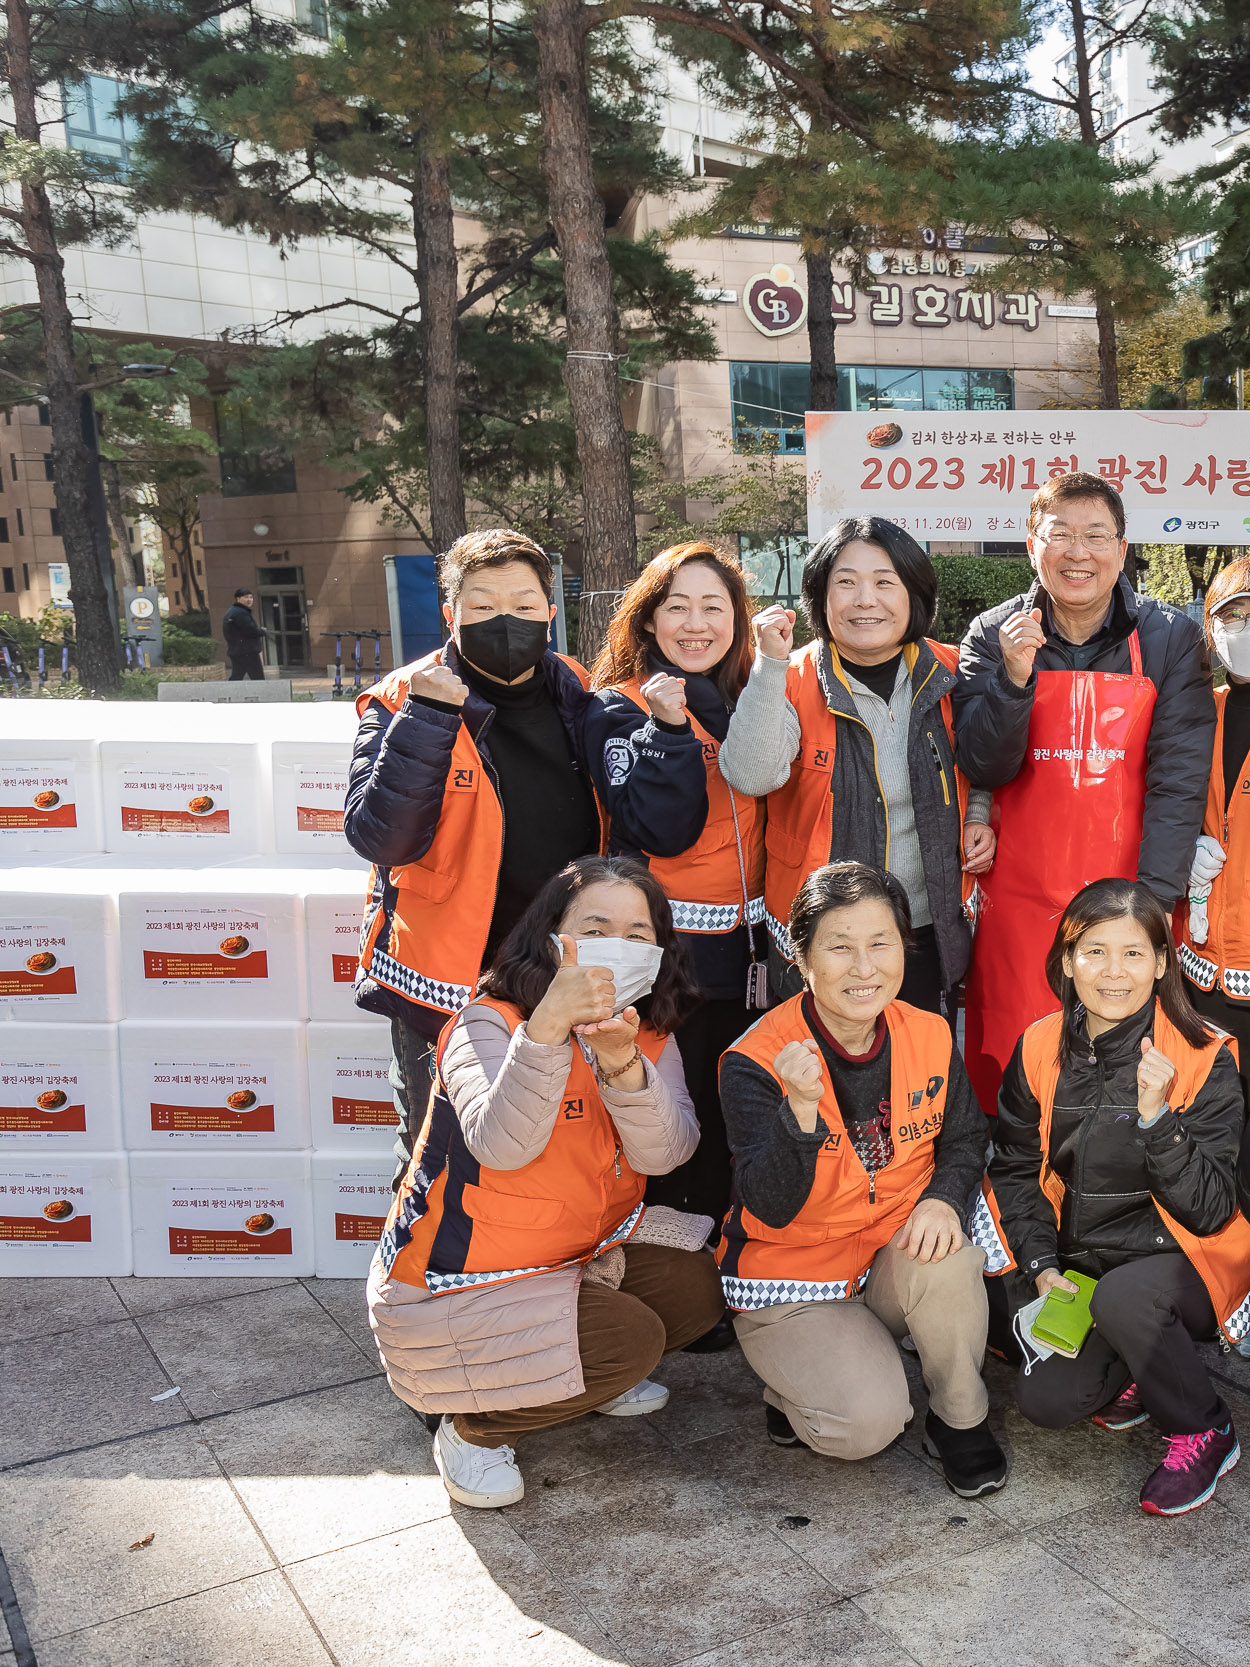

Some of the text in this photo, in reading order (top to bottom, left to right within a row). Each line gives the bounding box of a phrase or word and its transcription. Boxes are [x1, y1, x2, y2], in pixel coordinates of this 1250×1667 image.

[911, 431, 1077, 446] 김치 한상자로 전하는 안부
[860, 456, 966, 492] 2023
[1097, 454, 1168, 495] 광진
[935, 516, 973, 531] 20(월)
[1185, 520, 1221, 530] 광진구
[137, 601, 148, 615] P
[1033, 748, 1051, 761] 광진
[1053, 748, 1084, 761] 사랑의
[2, 778, 68, 788] 광진 사랑의 김장축제
[453, 769, 474, 788] 진
[159, 783, 173, 791] 광진
[174, 783, 194, 792] 사랑의
[197, 783, 223, 792] 김장축제
[146, 922, 163, 930] 2023
[186, 922, 201, 931] 광진
[203, 922, 226, 931] 사랑의
[228, 922, 259, 931] 김장축제
[335, 926, 352, 934] 2023
[8, 938, 33, 948] 사랑의
[34, 938, 66, 948] 김장축제
[336, 1069, 353, 1077] 2023
[2, 1075, 78, 1085] 광진 사랑의 김장축제
[154, 1075, 171, 1083] 2023
[194, 1075, 209, 1085] 광진
[210, 1075, 234, 1085] 사랑의
[236, 1075, 267, 1085] 김장축제
[563, 1098, 584, 1120] 진
[9, 1185, 25, 1195] 광진
[27, 1185, 51, 1196] 사랑의
[53, 1186, 84, 1196] 김장축제
[339, 1185, 355, 1194] 2023
[172, 1199, 189, 1207] 2023
[212, 1199, 227, 1209] 광진
[228, 1199, 252, 1209] 사랑의
[254, 1199, 285, 1209] 김장축제
